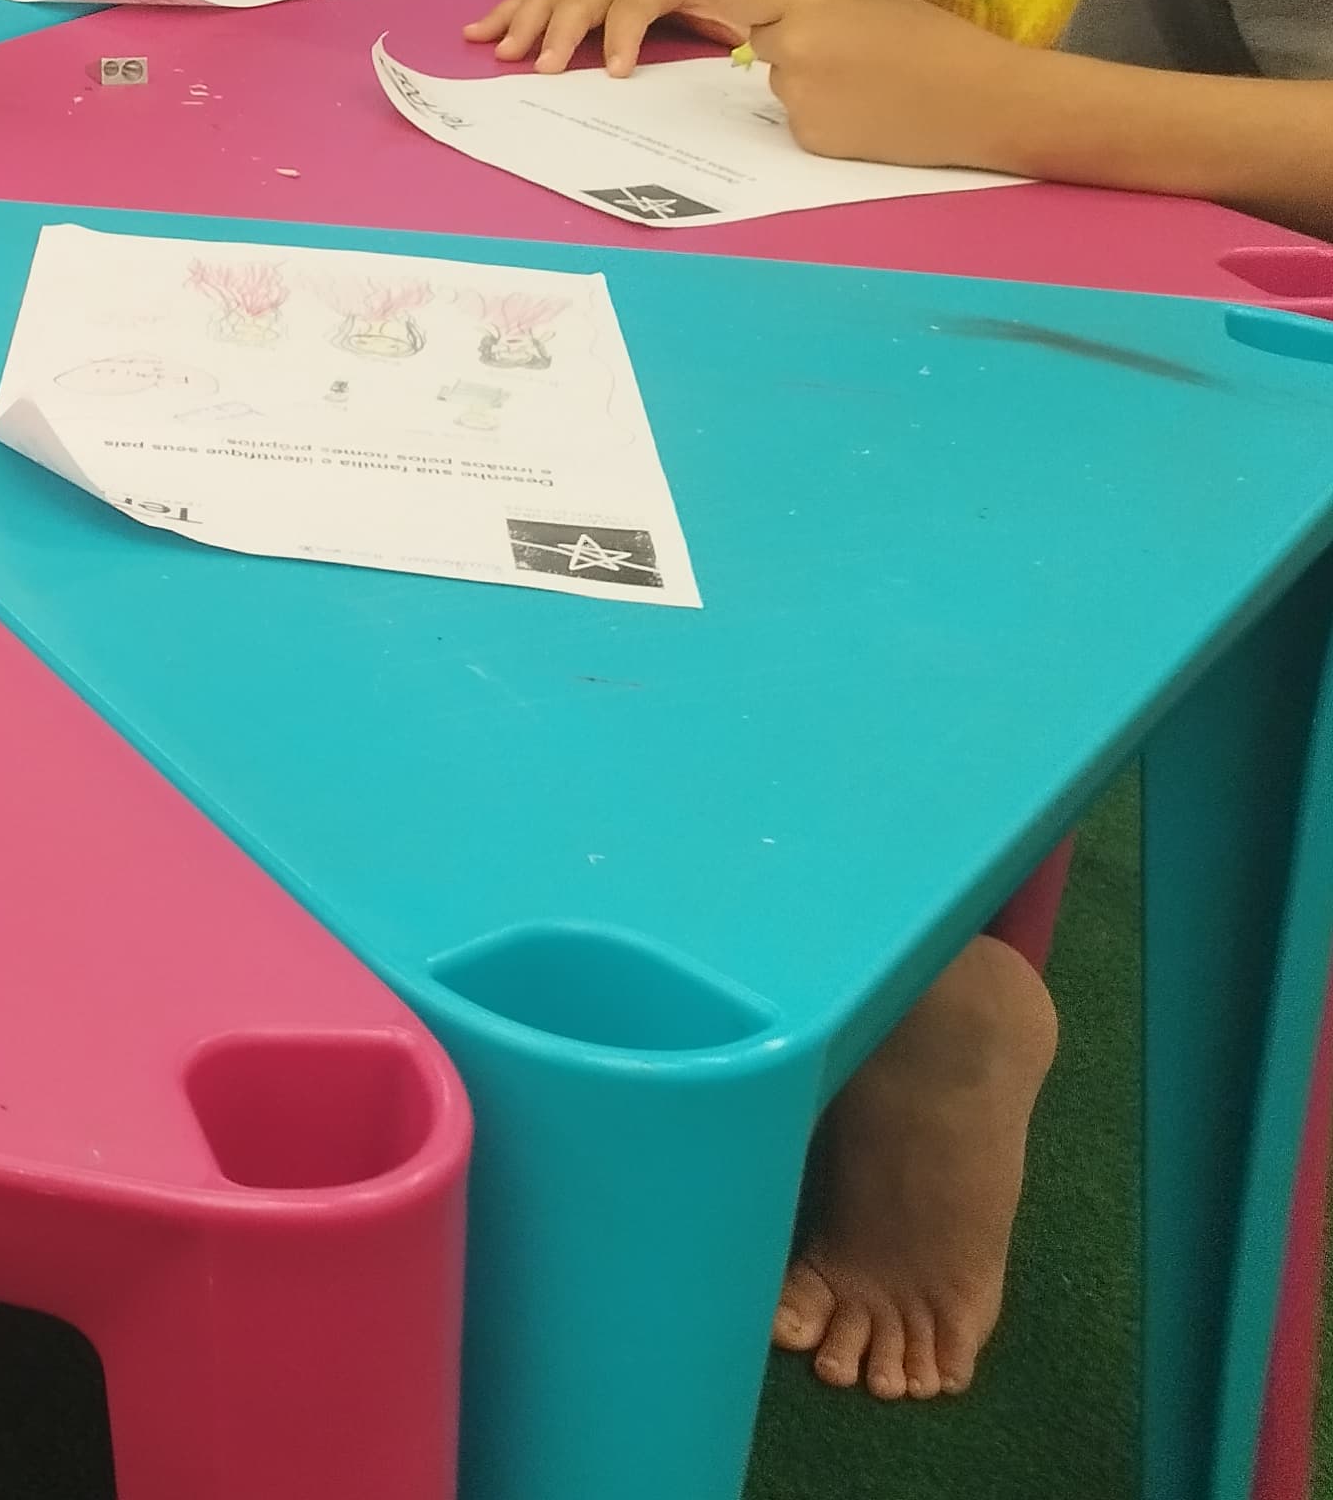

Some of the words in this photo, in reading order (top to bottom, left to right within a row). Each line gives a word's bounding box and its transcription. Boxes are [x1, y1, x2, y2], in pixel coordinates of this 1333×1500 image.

[103, 439, 145, 450] pais
[416, 466, 453, 476] sua
[461, 470, 554, 487] Desenhe
